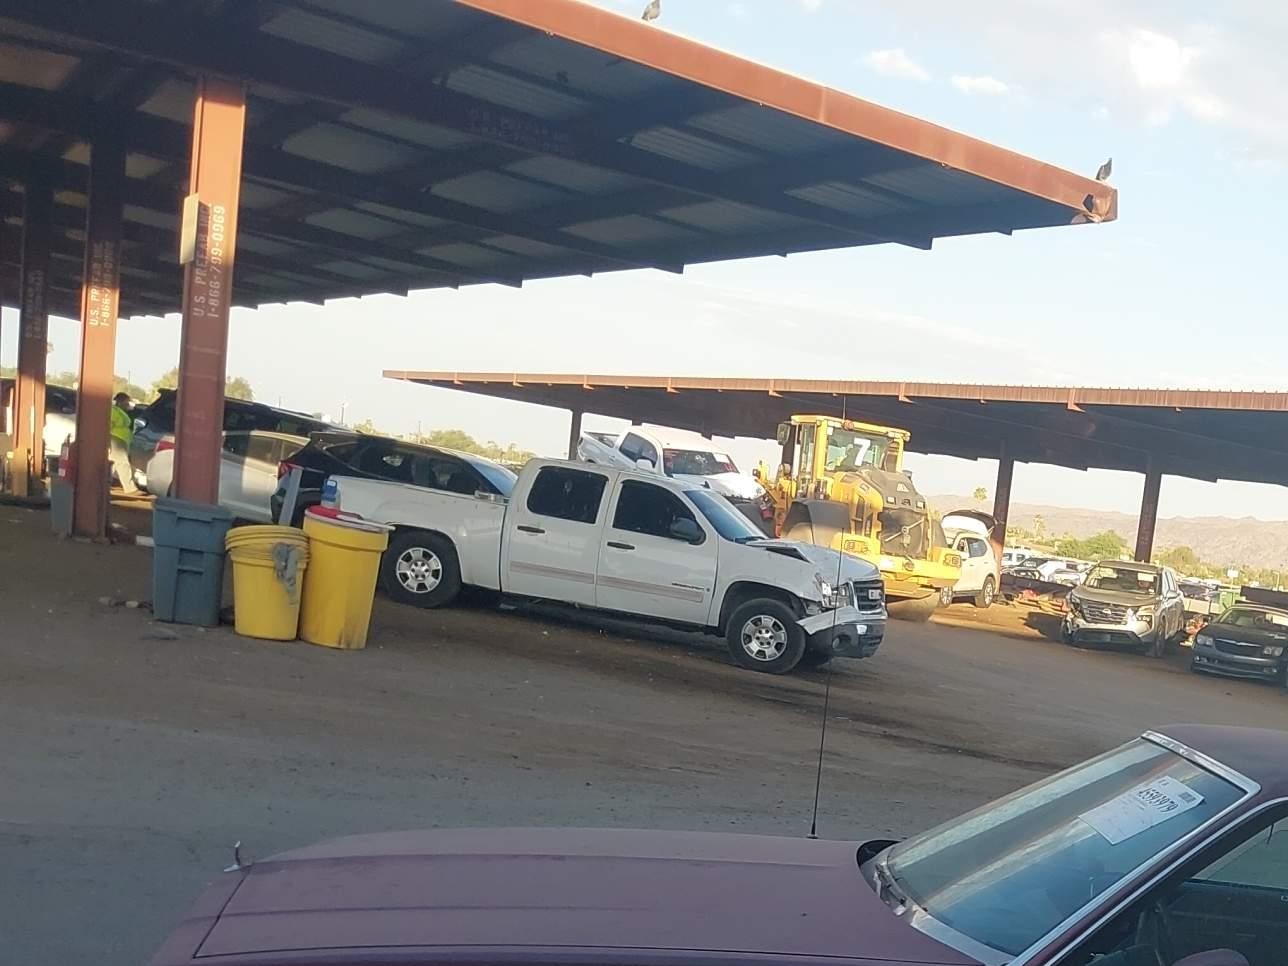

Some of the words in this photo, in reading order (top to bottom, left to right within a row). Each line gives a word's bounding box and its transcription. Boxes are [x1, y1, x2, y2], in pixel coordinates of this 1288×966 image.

[194, 233, 209, 286] PREFAB
[207, 205, 225, 318] 1-866-799-0969
[192, 291, 206, 317] U.S.
[853, 437, 871, 467] 7
